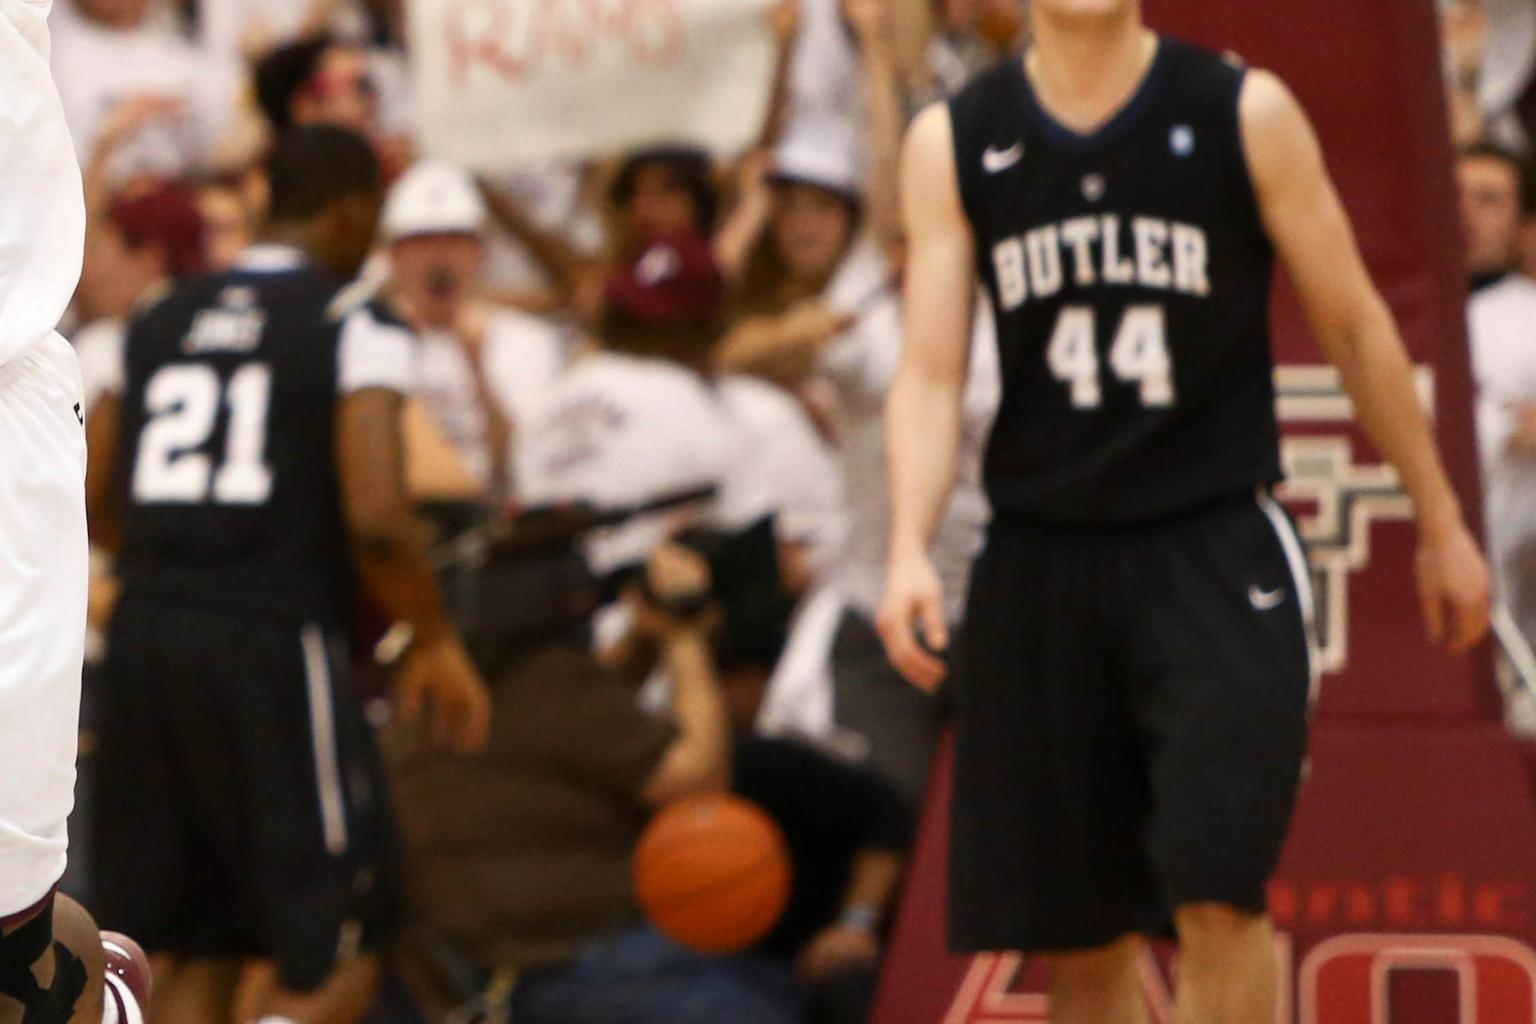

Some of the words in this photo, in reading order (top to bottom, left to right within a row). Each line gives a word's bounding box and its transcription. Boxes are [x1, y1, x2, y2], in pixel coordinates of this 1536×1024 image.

[992, 213, 1212, 312] BUTLER
[1045, 304, 1175, 409] 44
[131, 361, 274, 506] 21
